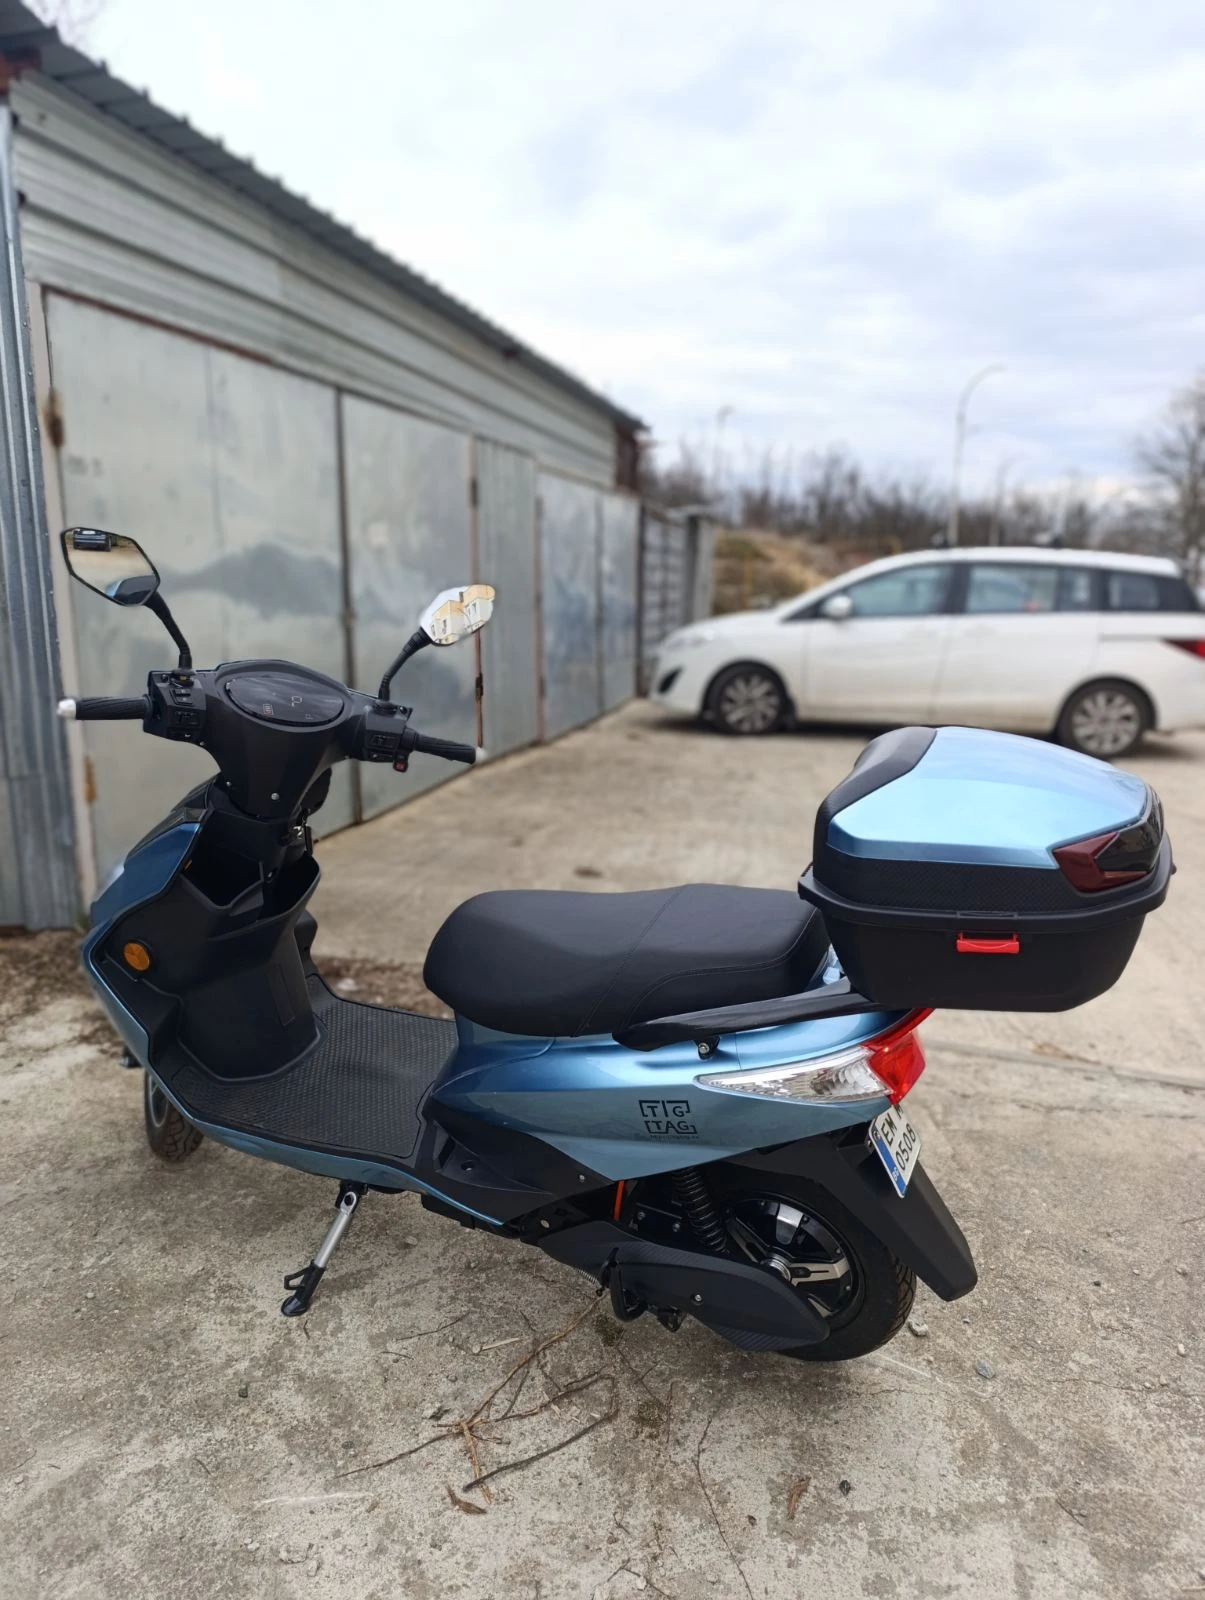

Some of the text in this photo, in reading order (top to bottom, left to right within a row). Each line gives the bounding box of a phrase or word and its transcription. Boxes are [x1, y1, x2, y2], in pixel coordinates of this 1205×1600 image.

[640, 1100, 690, 1117] TIG
[645, 1120, 697, 1134] TAG
[881, 1112, 898, 1147] EM
[895, 1122, 916, 1171] 0508
